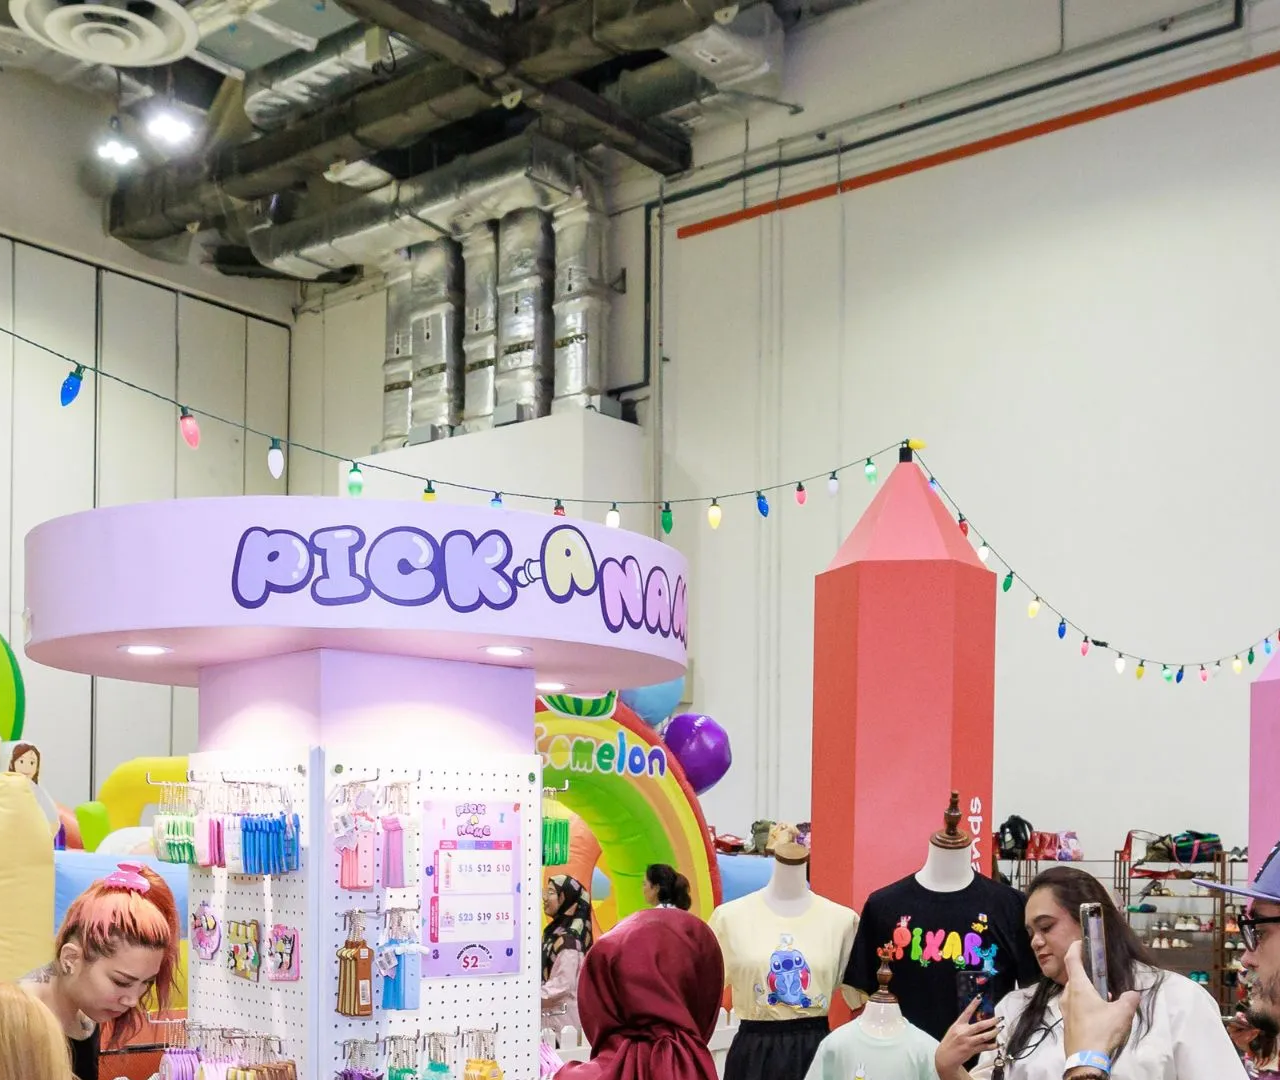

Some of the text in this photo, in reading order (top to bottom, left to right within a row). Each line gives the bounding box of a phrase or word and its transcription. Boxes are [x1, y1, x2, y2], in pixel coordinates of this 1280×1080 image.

[231, 525, 517, 613] PICK
[540, 524, 598, 604] A
[477, 864, 492, 873] $12
[496, 864, 511, 873] $10
[477, 912, 492, 922] $19
[496, 912, 510, 921] $15
[892, 926, 982, 966] PIXAR
[462, 955, 479, 969] $2
